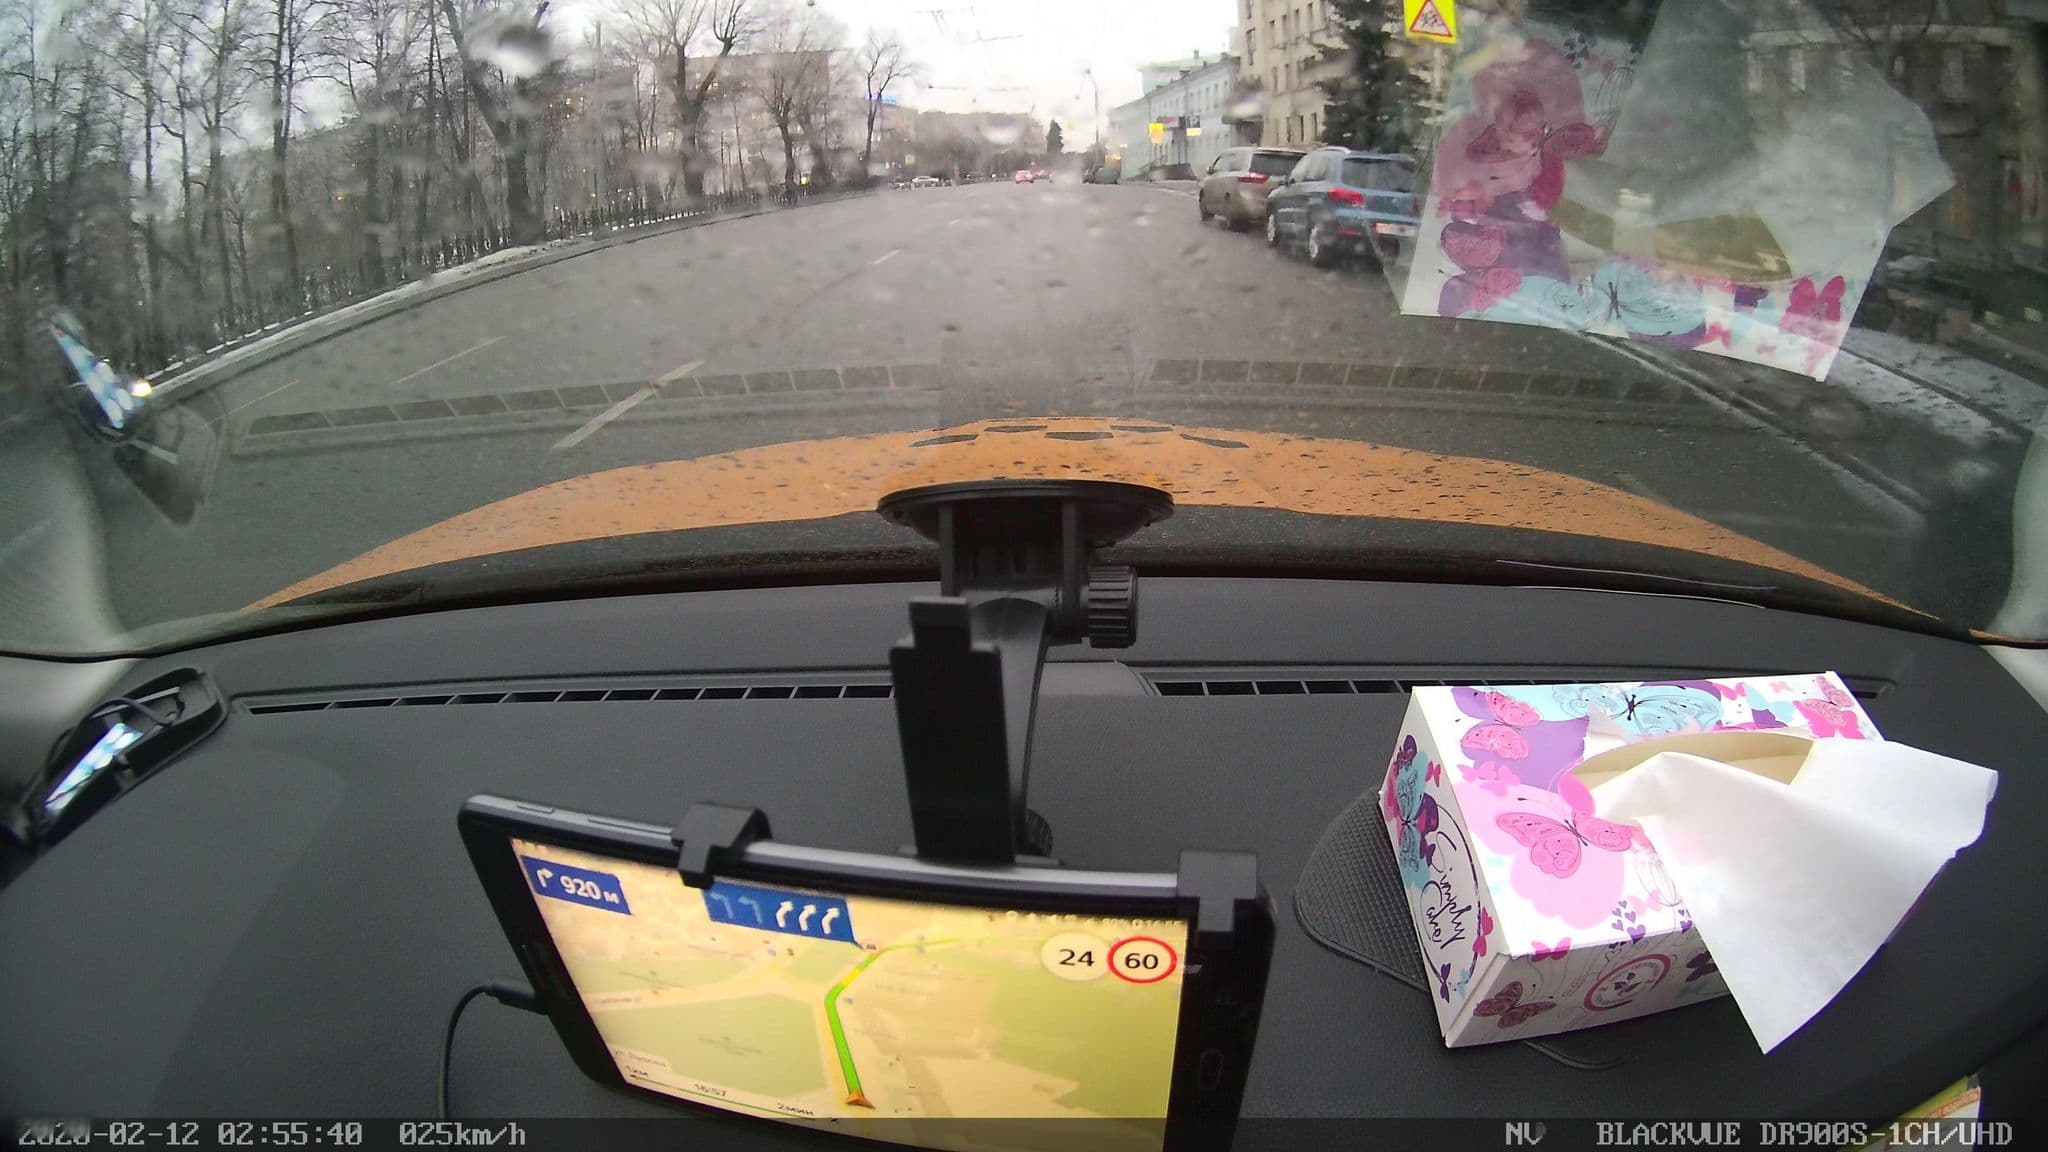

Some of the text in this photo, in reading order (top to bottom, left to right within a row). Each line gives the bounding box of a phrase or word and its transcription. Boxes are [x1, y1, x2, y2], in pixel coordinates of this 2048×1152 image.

[559, 875, 602, 901] 920
[1431, 830, 1472, 950] Simply
[1058, 948, 1095, 967] 24
[1124, 952, 1159, 970] 60
